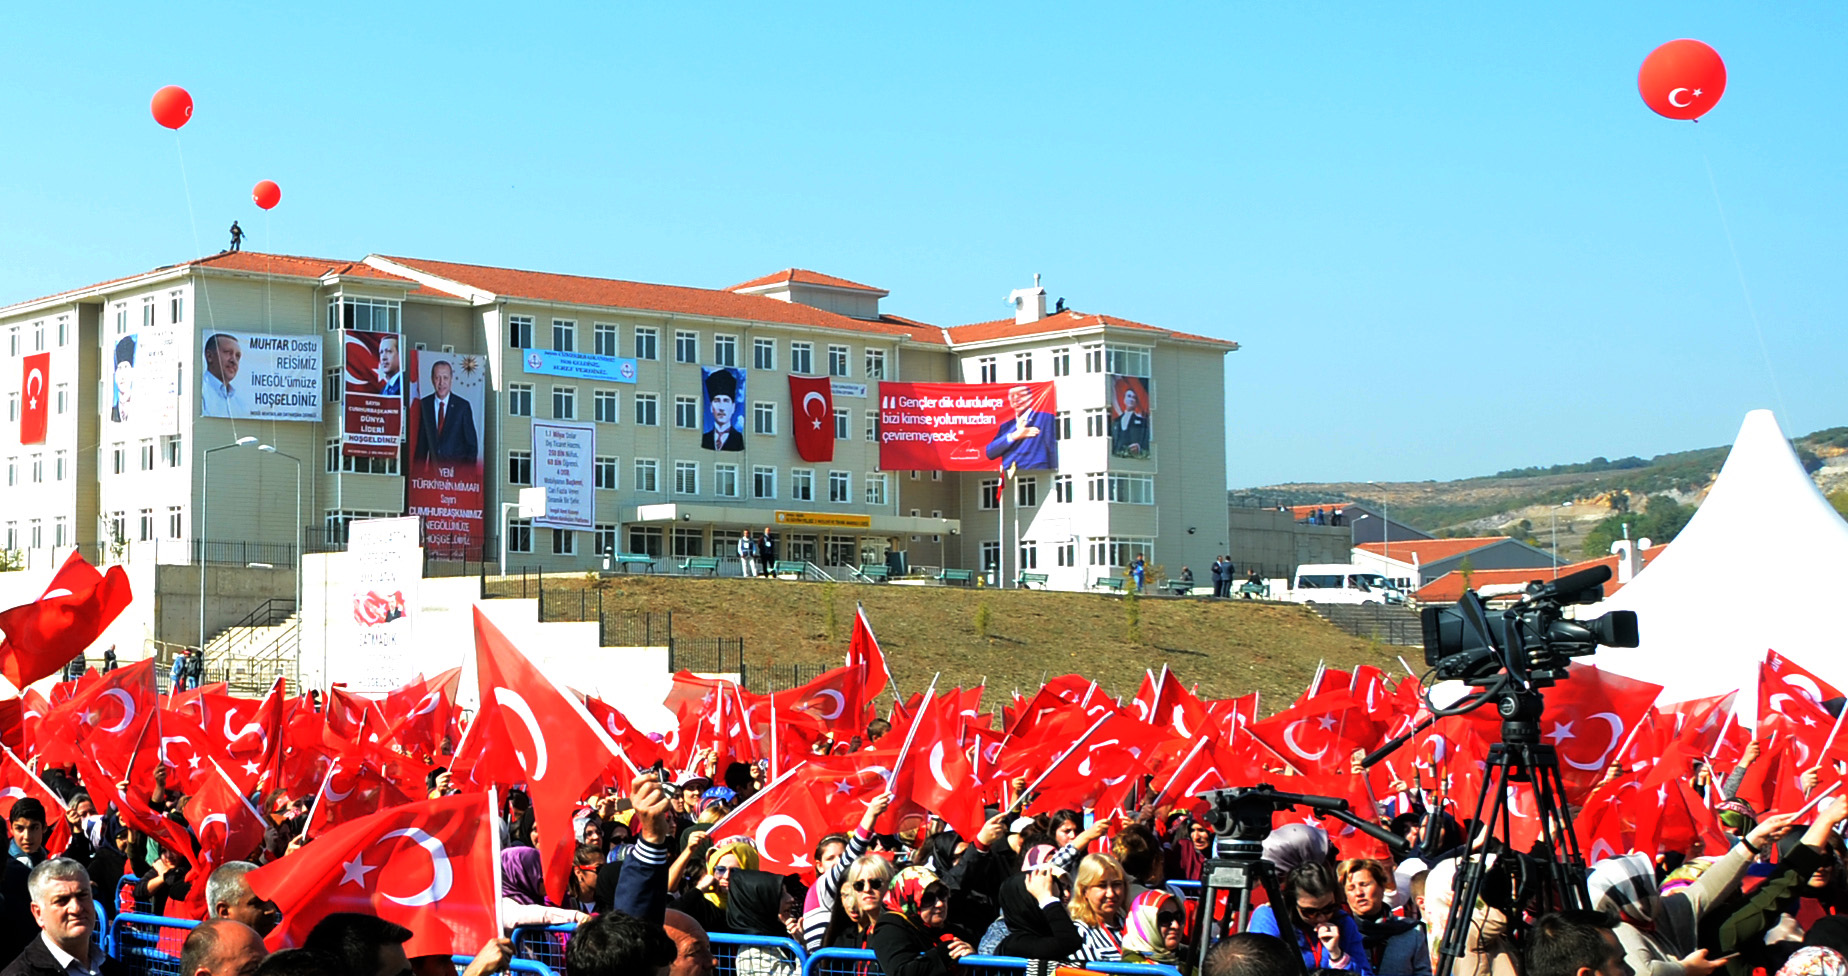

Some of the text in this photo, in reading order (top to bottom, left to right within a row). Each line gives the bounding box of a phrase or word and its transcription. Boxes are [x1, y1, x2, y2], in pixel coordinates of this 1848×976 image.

[250, 338, 317, 352] MUHTAR Dostu
[277, 356, 317, 370] REİSİMİZ
[251, 372, 317, 389] İNEGÖL'ümüze
[255, 392, 317, 408] HOŞGELDİNİZ
[899, 396, 1004, 410] Gençler dik durdukça
[360, 415, 385, 424] DÜNYA
[882, 411, 996, 428] bizi kimse yolumuzdan
[360, 425, 385, 434] LİDERİ
[348, 435, 397, 444] HOŞGELDİNİZ
[438, 466, 454, 478] YENİ
[440, 494, 456, 506] Sayın
[409, 506, 483, 519] CUMHURBAŞKANIMIZ
[425, 519, 470, 532] NEGÖLÜMÜZE
